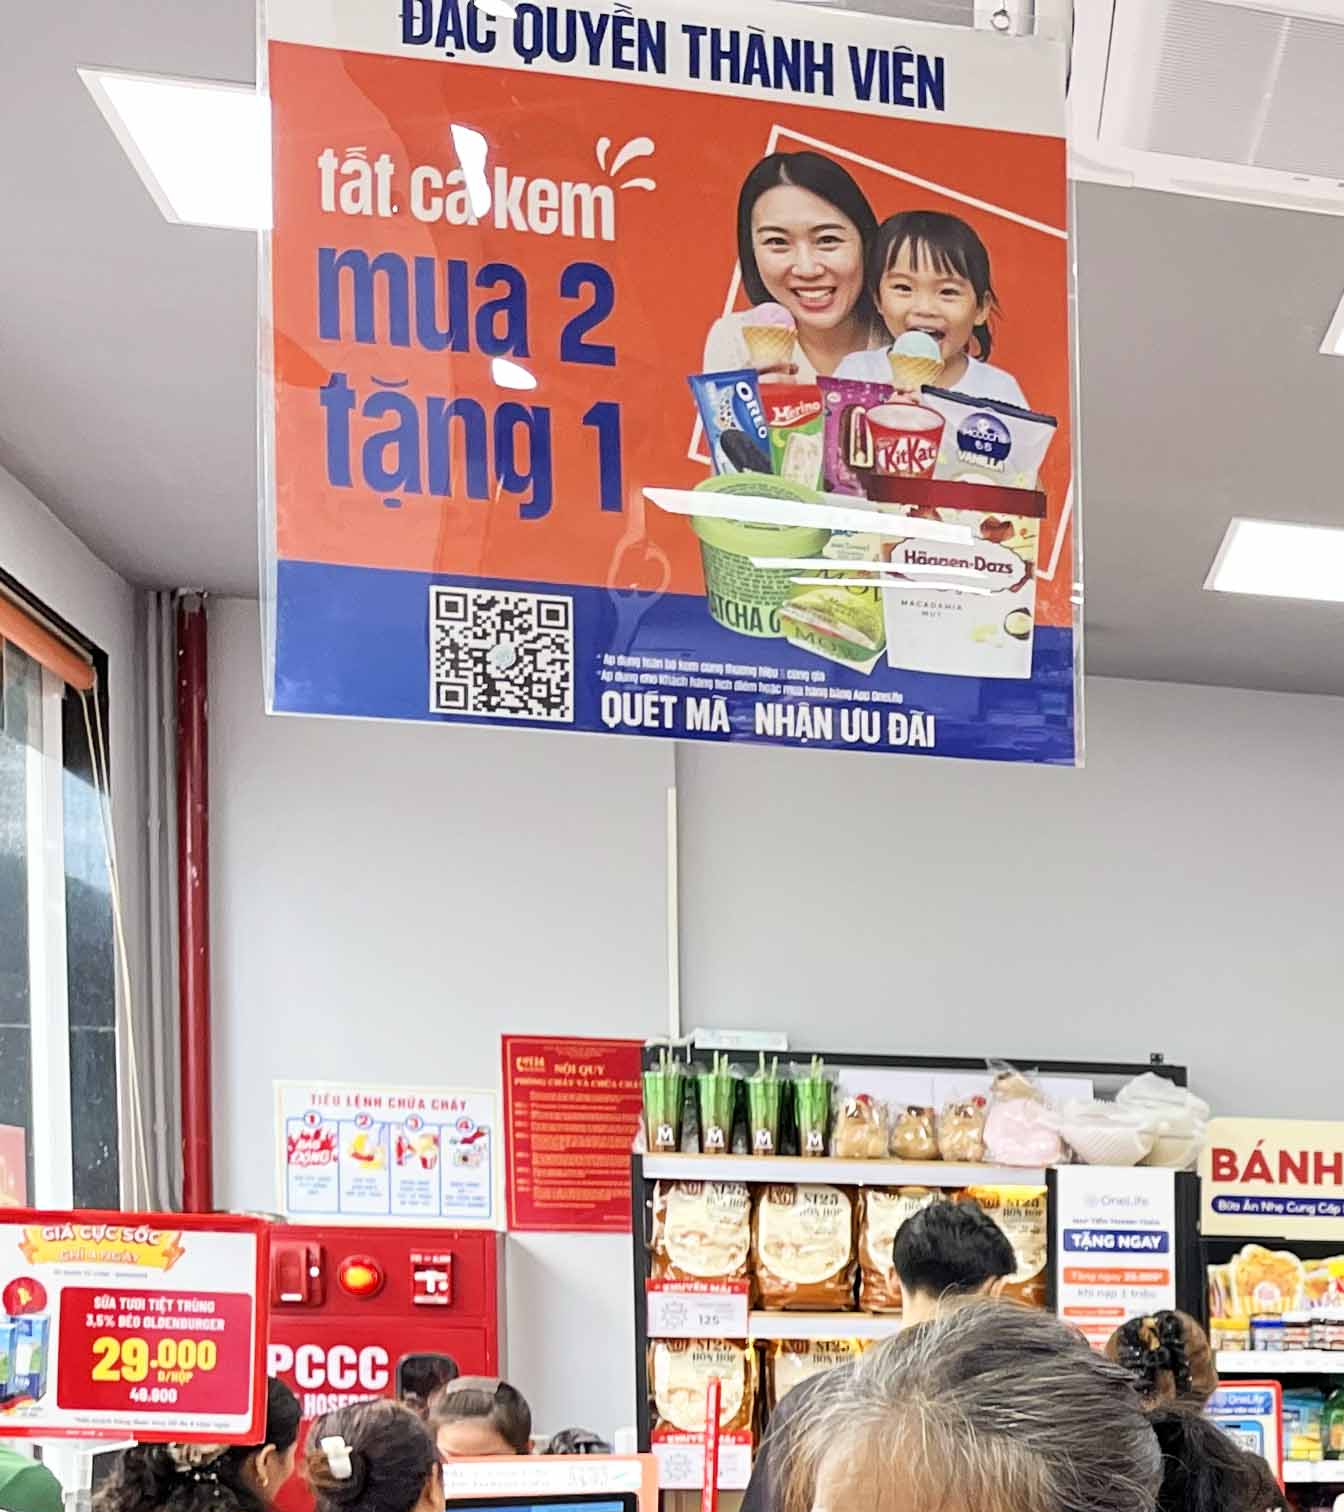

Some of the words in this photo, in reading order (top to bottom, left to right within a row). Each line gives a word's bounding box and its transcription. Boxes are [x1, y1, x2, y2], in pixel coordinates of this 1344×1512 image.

[513, 3, 667, 75] QUYỀN
[682, 25, 834, 97] THÀNH
[848, 44, 945, 112] VIÊN
[494, 166, 615, 241] kem
[318, 248, 530, 361] mua
[559, 261, 618, 368] 2
[735, 381, 768, 440] OREO
[771, 398, 821, 427] Merino
[320, 373, 555, 521] tặng
[581, 401, 623, 513] 1
[881, 437, 938, 474] KitKat
[601, 690, 678, 728] QUÉT
[685, 693, 731, 733] MÃ
[754, 702, 833, 743] NHẬN
[840, 707, 881, 744] ƯU
[888, 708, 936, 749] ĐÃI
[346, 1094, 383, 1109] LỆNH
[387, 1095, 426, 1110] CHỮA
[431, 1096, 467, 1111] CHÁY
[1210, 1138, 1343, 1187] BÁNH
[1286, 1201, 1316, 1216] Cung
[41, 1223, 76, 1243] GIÁ
[78, 1227, 118, 1245] CỰC
[121, 1224, 161, 1245] SỐC
[1071, 1231, 1115, 1250] TẶNG
[1117, 1234, 1162, 1249] NGAY
[93, 1294, 117, 1311] SỮA
[91, 1336, 217, 1383] 29.000
[267, 1343, 390, 1391] PCCC
